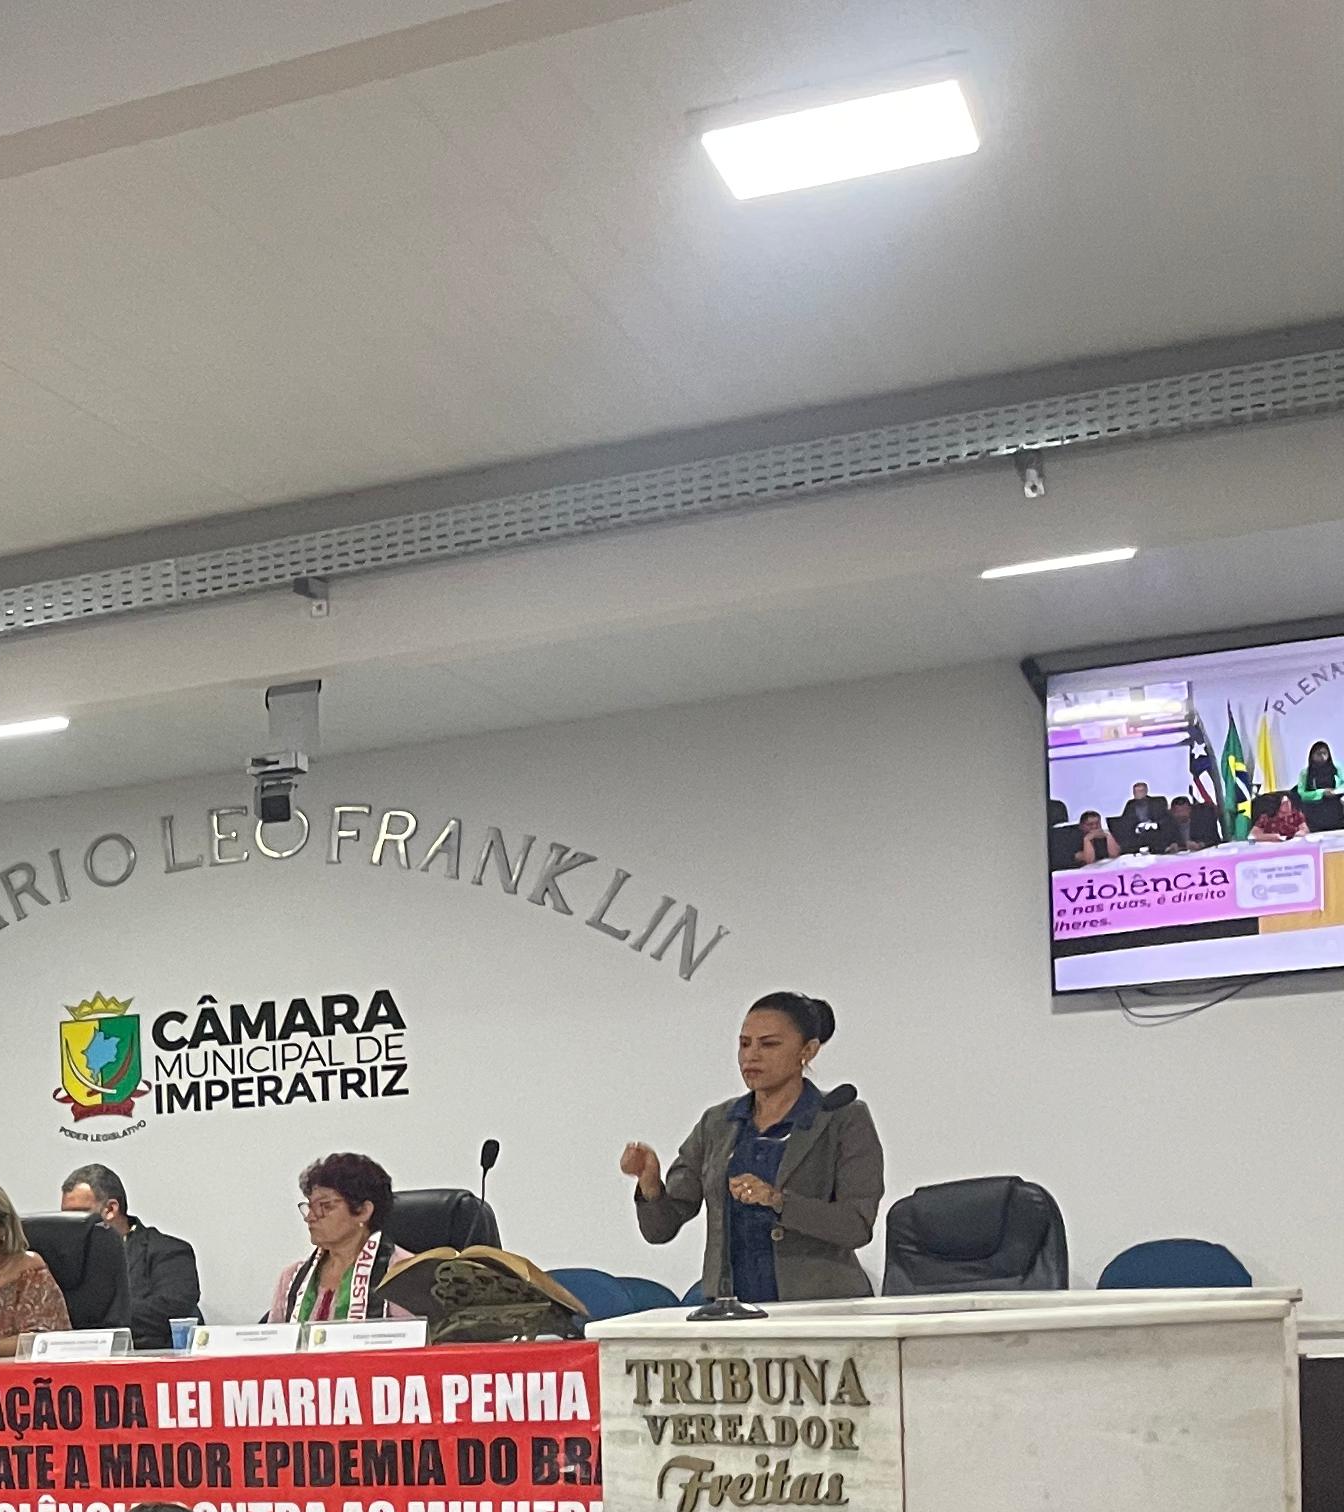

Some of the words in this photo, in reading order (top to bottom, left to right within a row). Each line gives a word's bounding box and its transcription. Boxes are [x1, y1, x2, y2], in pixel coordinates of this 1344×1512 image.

[159, 805, 310, 875] LEO
[324, 803, 731, 982] FRANKLIN
[1060, 866, 1230, 903] violência
[1072, 904, 1105, 915] nas
[1172, 888, 1227, 904] direito
[151, 989, 407, 1052] CÂMARA
[154, 1038, 345, 1082] MUNICIPAL
[356, 1033, 406, 1064] DE
[154, 1063, 410, 1115] IMPERATRIZ
[58, 1126, 89, 1142] PODER
[90, 1120, 147, 1142] LEGISLATIVO
[93, 1383, 149, 1430] DA
[156, 1381, 212, 1428] LEI
[222, 1375, 363, 1428] MARIA
[372, 1374, 432, 1426] DA
[441, 1371, 592, 1424] PENHA
[625, 1355, 871, 1408] TRIBUNA
[643, 1414, 859, 1452] VEREADOR
[63, 1444, 91, 1490] A
[99, 1441, 232, 1490] MAIOR
[243, 1438, 446, 1489] EPIDEMIA
[457, 1436, 519, 1487] DO
[530, 1436, 602, 1487] BR
